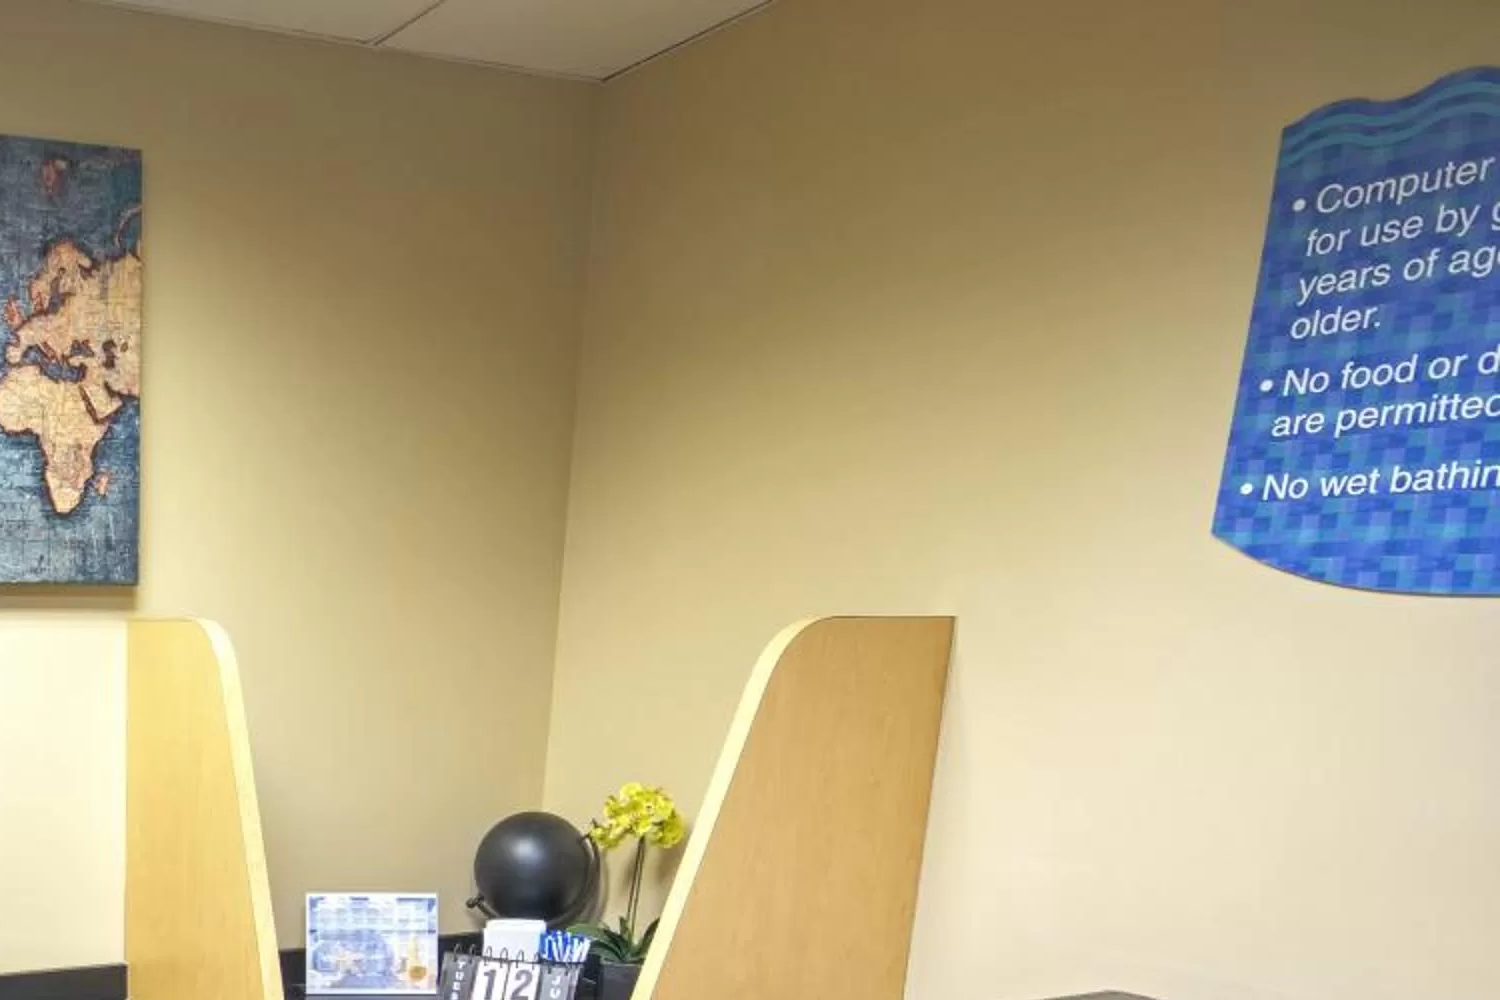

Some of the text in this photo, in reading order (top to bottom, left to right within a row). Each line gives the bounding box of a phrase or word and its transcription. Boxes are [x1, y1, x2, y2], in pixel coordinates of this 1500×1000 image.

[1316, 156, 1496, 214] Computer
[1306, 228, 1351, 257] for
[1360, 214, 1424, 247] use
[1435, 203, 1481, 237] by
[1297, 244, 1500, 307] years of ag
[1290, 306, 1381, 340] older.
[1282, 367, 1330, 397] No
[1341, 353, 1419, 390] food
[1427, 353, 1469, 380] or
[1271, 411, 1325, 438] are
[1262, 472, 1309, 501] No
[1320, 468, 1381, 497] wet
